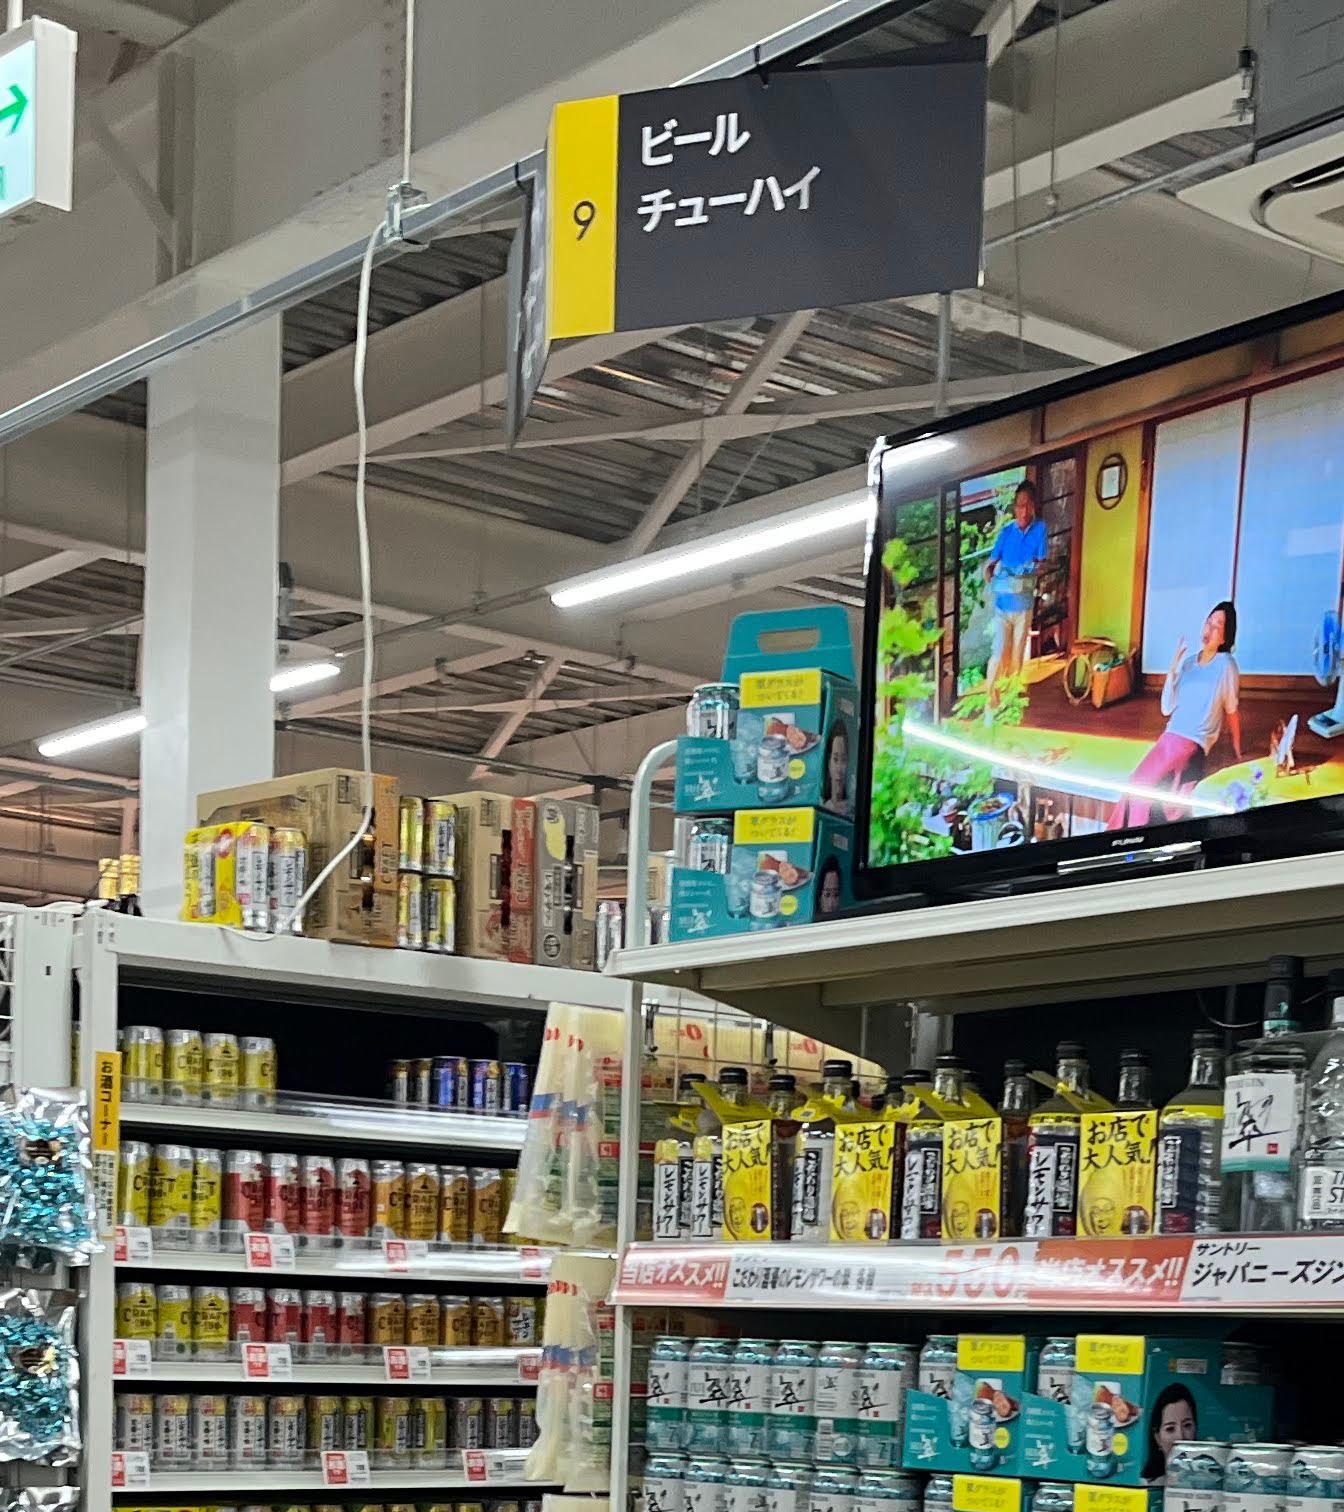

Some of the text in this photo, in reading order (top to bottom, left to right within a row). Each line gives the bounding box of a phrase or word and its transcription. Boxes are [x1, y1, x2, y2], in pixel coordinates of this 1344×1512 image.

[641, 112, 751, 166] ビール
[637, 166, 821, 232] チューハイ
[573, 200, 596, 241] 9
[840, 1124, 886, 1152] お店で
[948, 1119, 995, 1150] お店で
[1088, 1113, 1150, 1145] お店で
[834, 1150, 893, 1178] 大人気!
[945, 1143, 1002, 1177] 大人気!
[1082, 1137, 1157, 1172] 大人気!
[1195, 1242, 1261, 1257] サントリー
